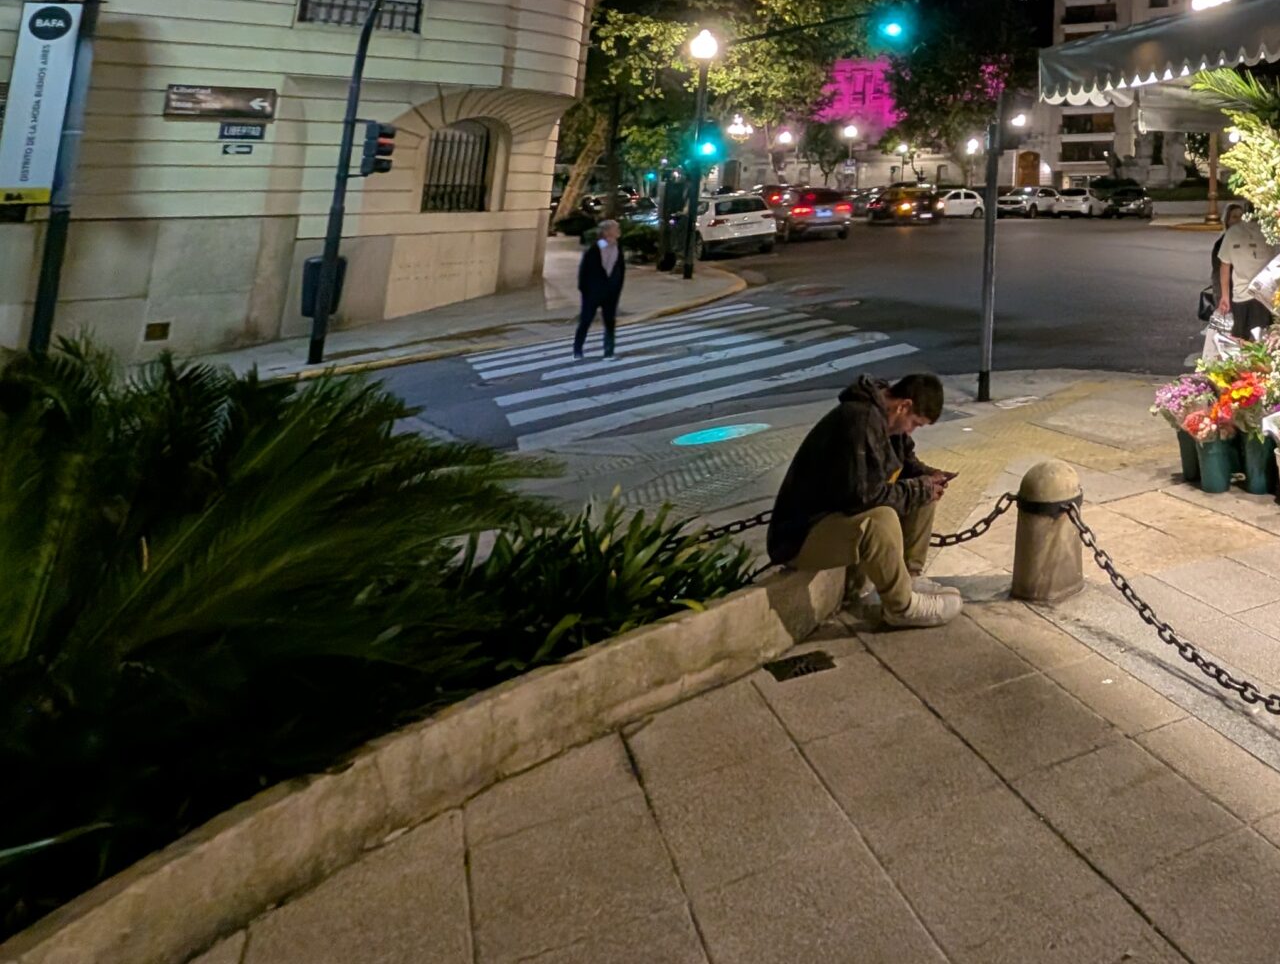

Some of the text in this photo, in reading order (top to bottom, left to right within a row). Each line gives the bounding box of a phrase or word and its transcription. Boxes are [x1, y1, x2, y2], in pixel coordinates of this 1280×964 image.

[35, 18, 65, 28] BAFA
[19, 44, 51, 182] DISTRITO DE LA MODA BUENOS AIRES
